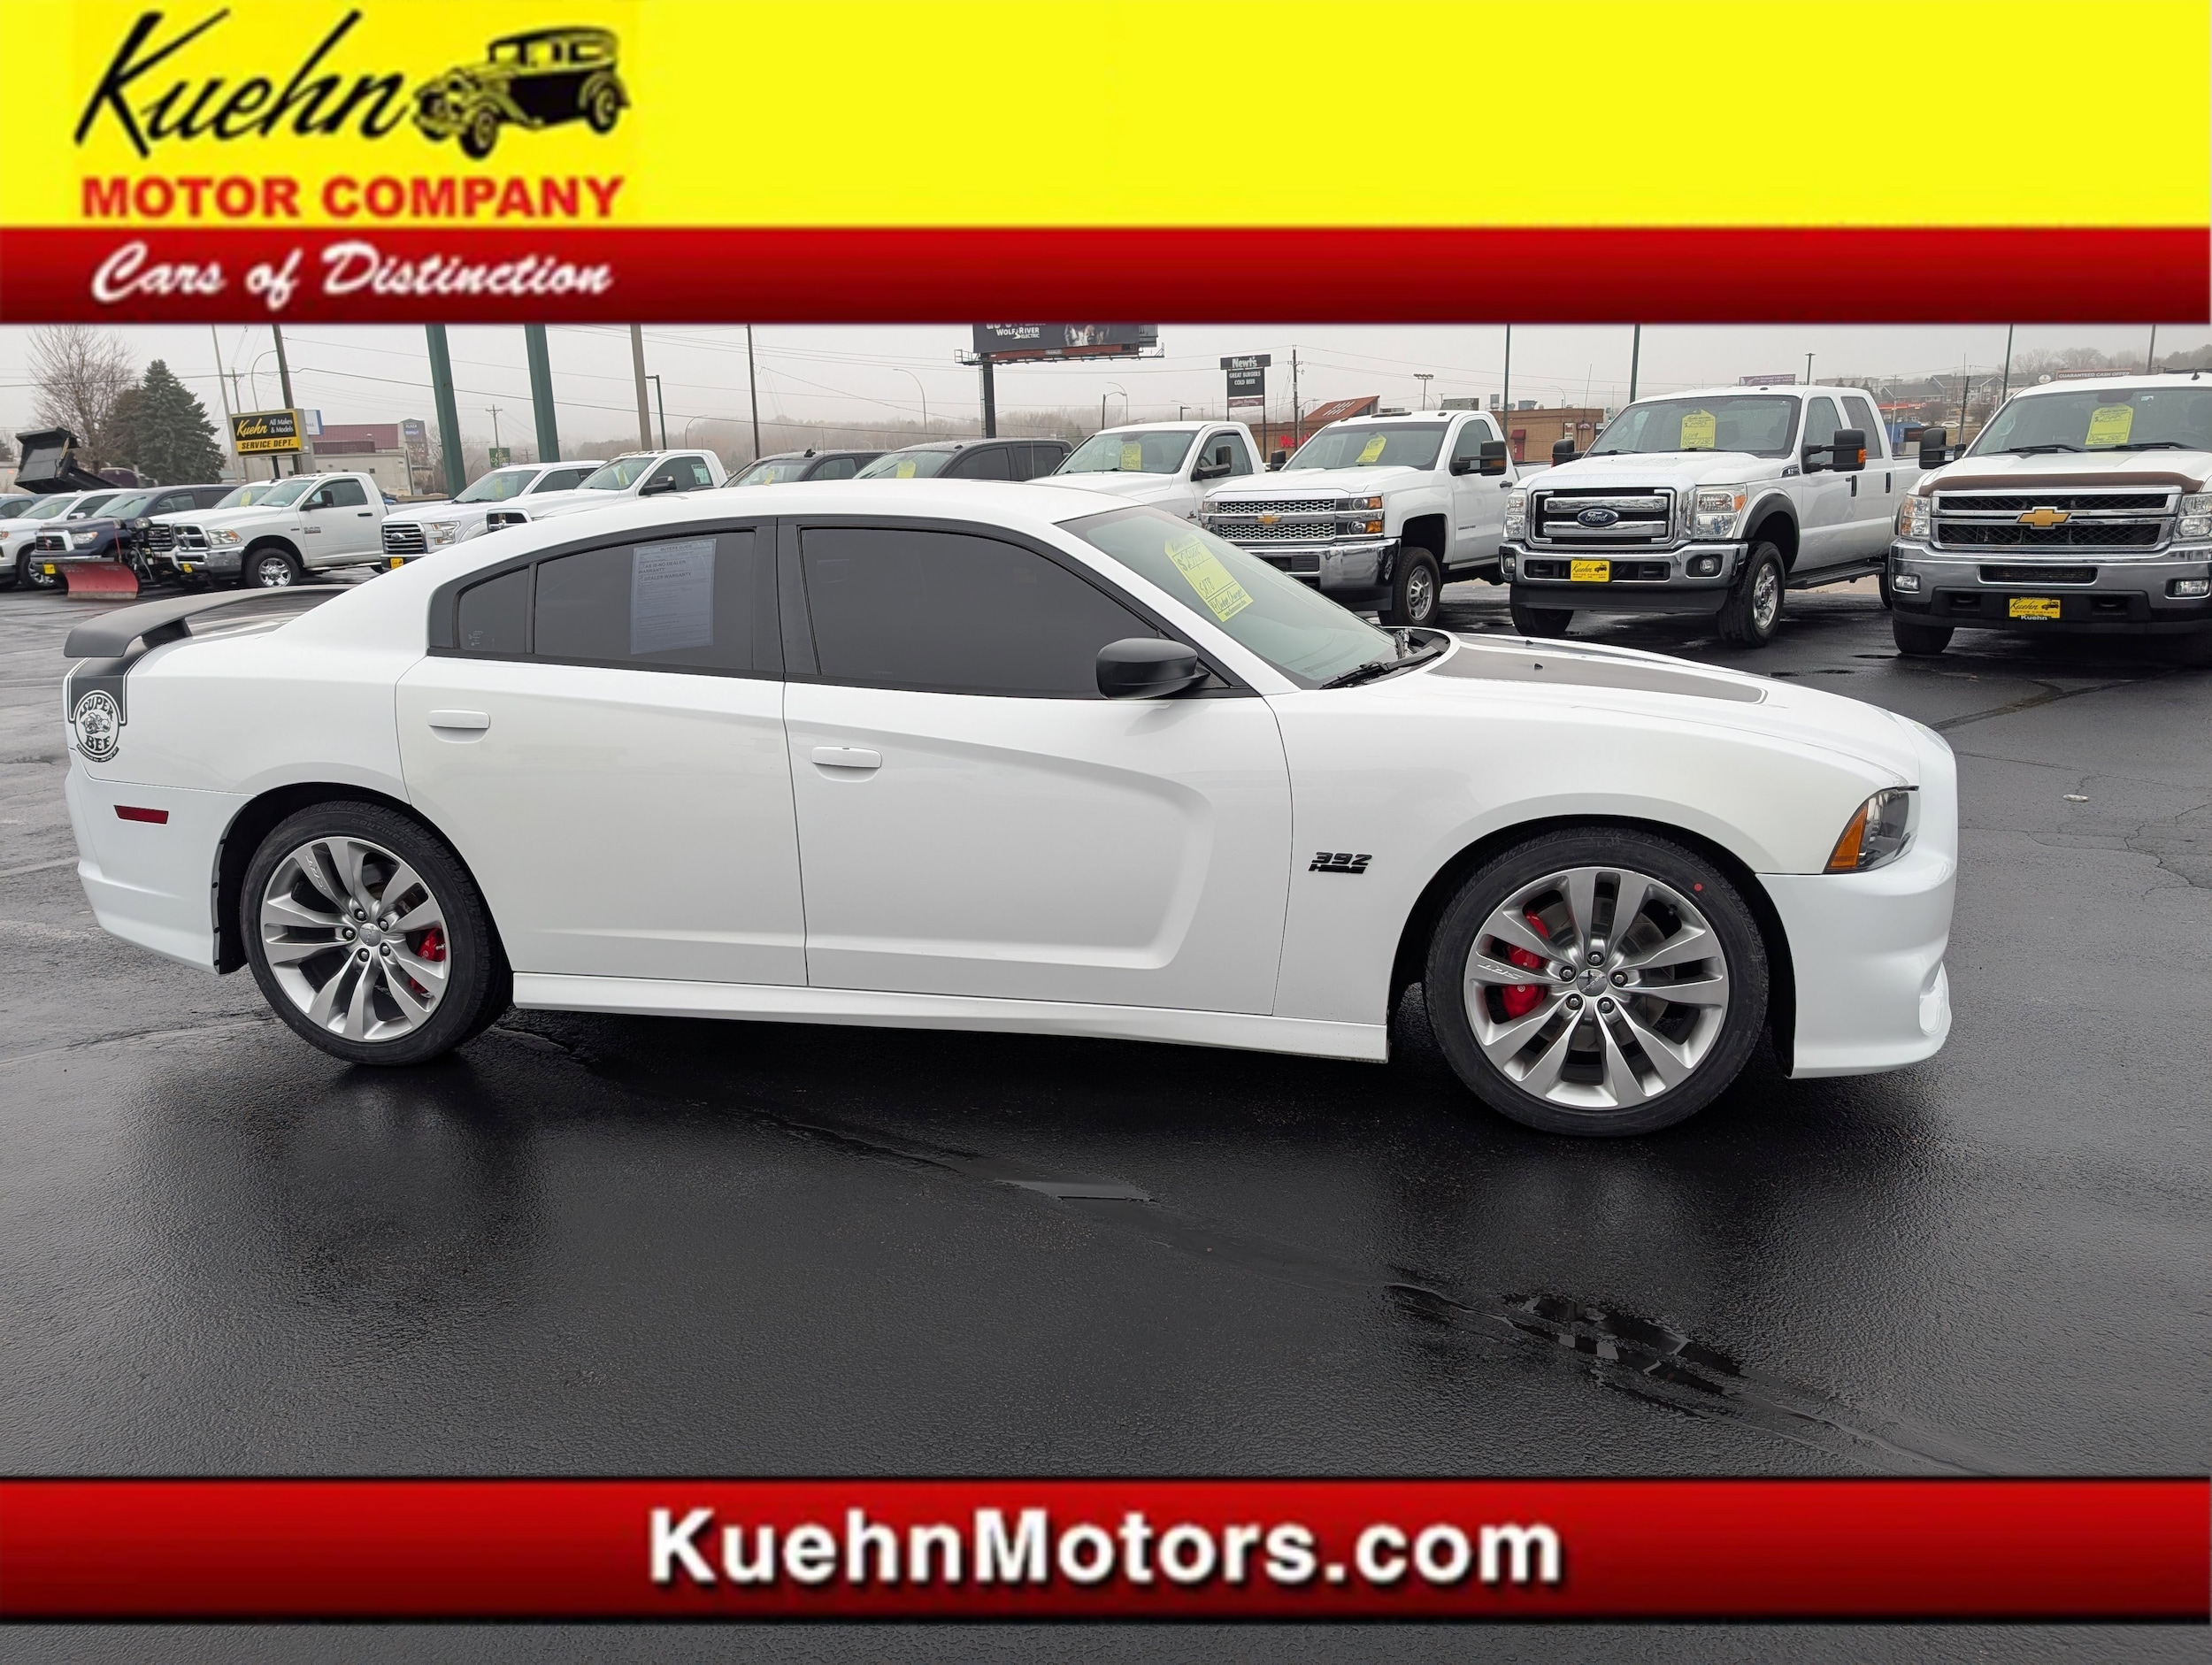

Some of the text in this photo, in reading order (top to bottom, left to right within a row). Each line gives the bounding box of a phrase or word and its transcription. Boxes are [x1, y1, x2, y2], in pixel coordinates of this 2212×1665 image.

[1232, 356, 1258, 369] Newt's
[236, 418, 268, 438] Kuehn
[242, 440, 271, 449] SERVICE
[1586, 511, 1608, 522] Ford
[1571, 562, 1593, 573] Kuehn
[2010, 600, 2039, 610] Kuehn
[80, 695, 113, 721] SUPER
[84, 734, 111, 751] BEE
[1311, 851, 1373, 866] 392
